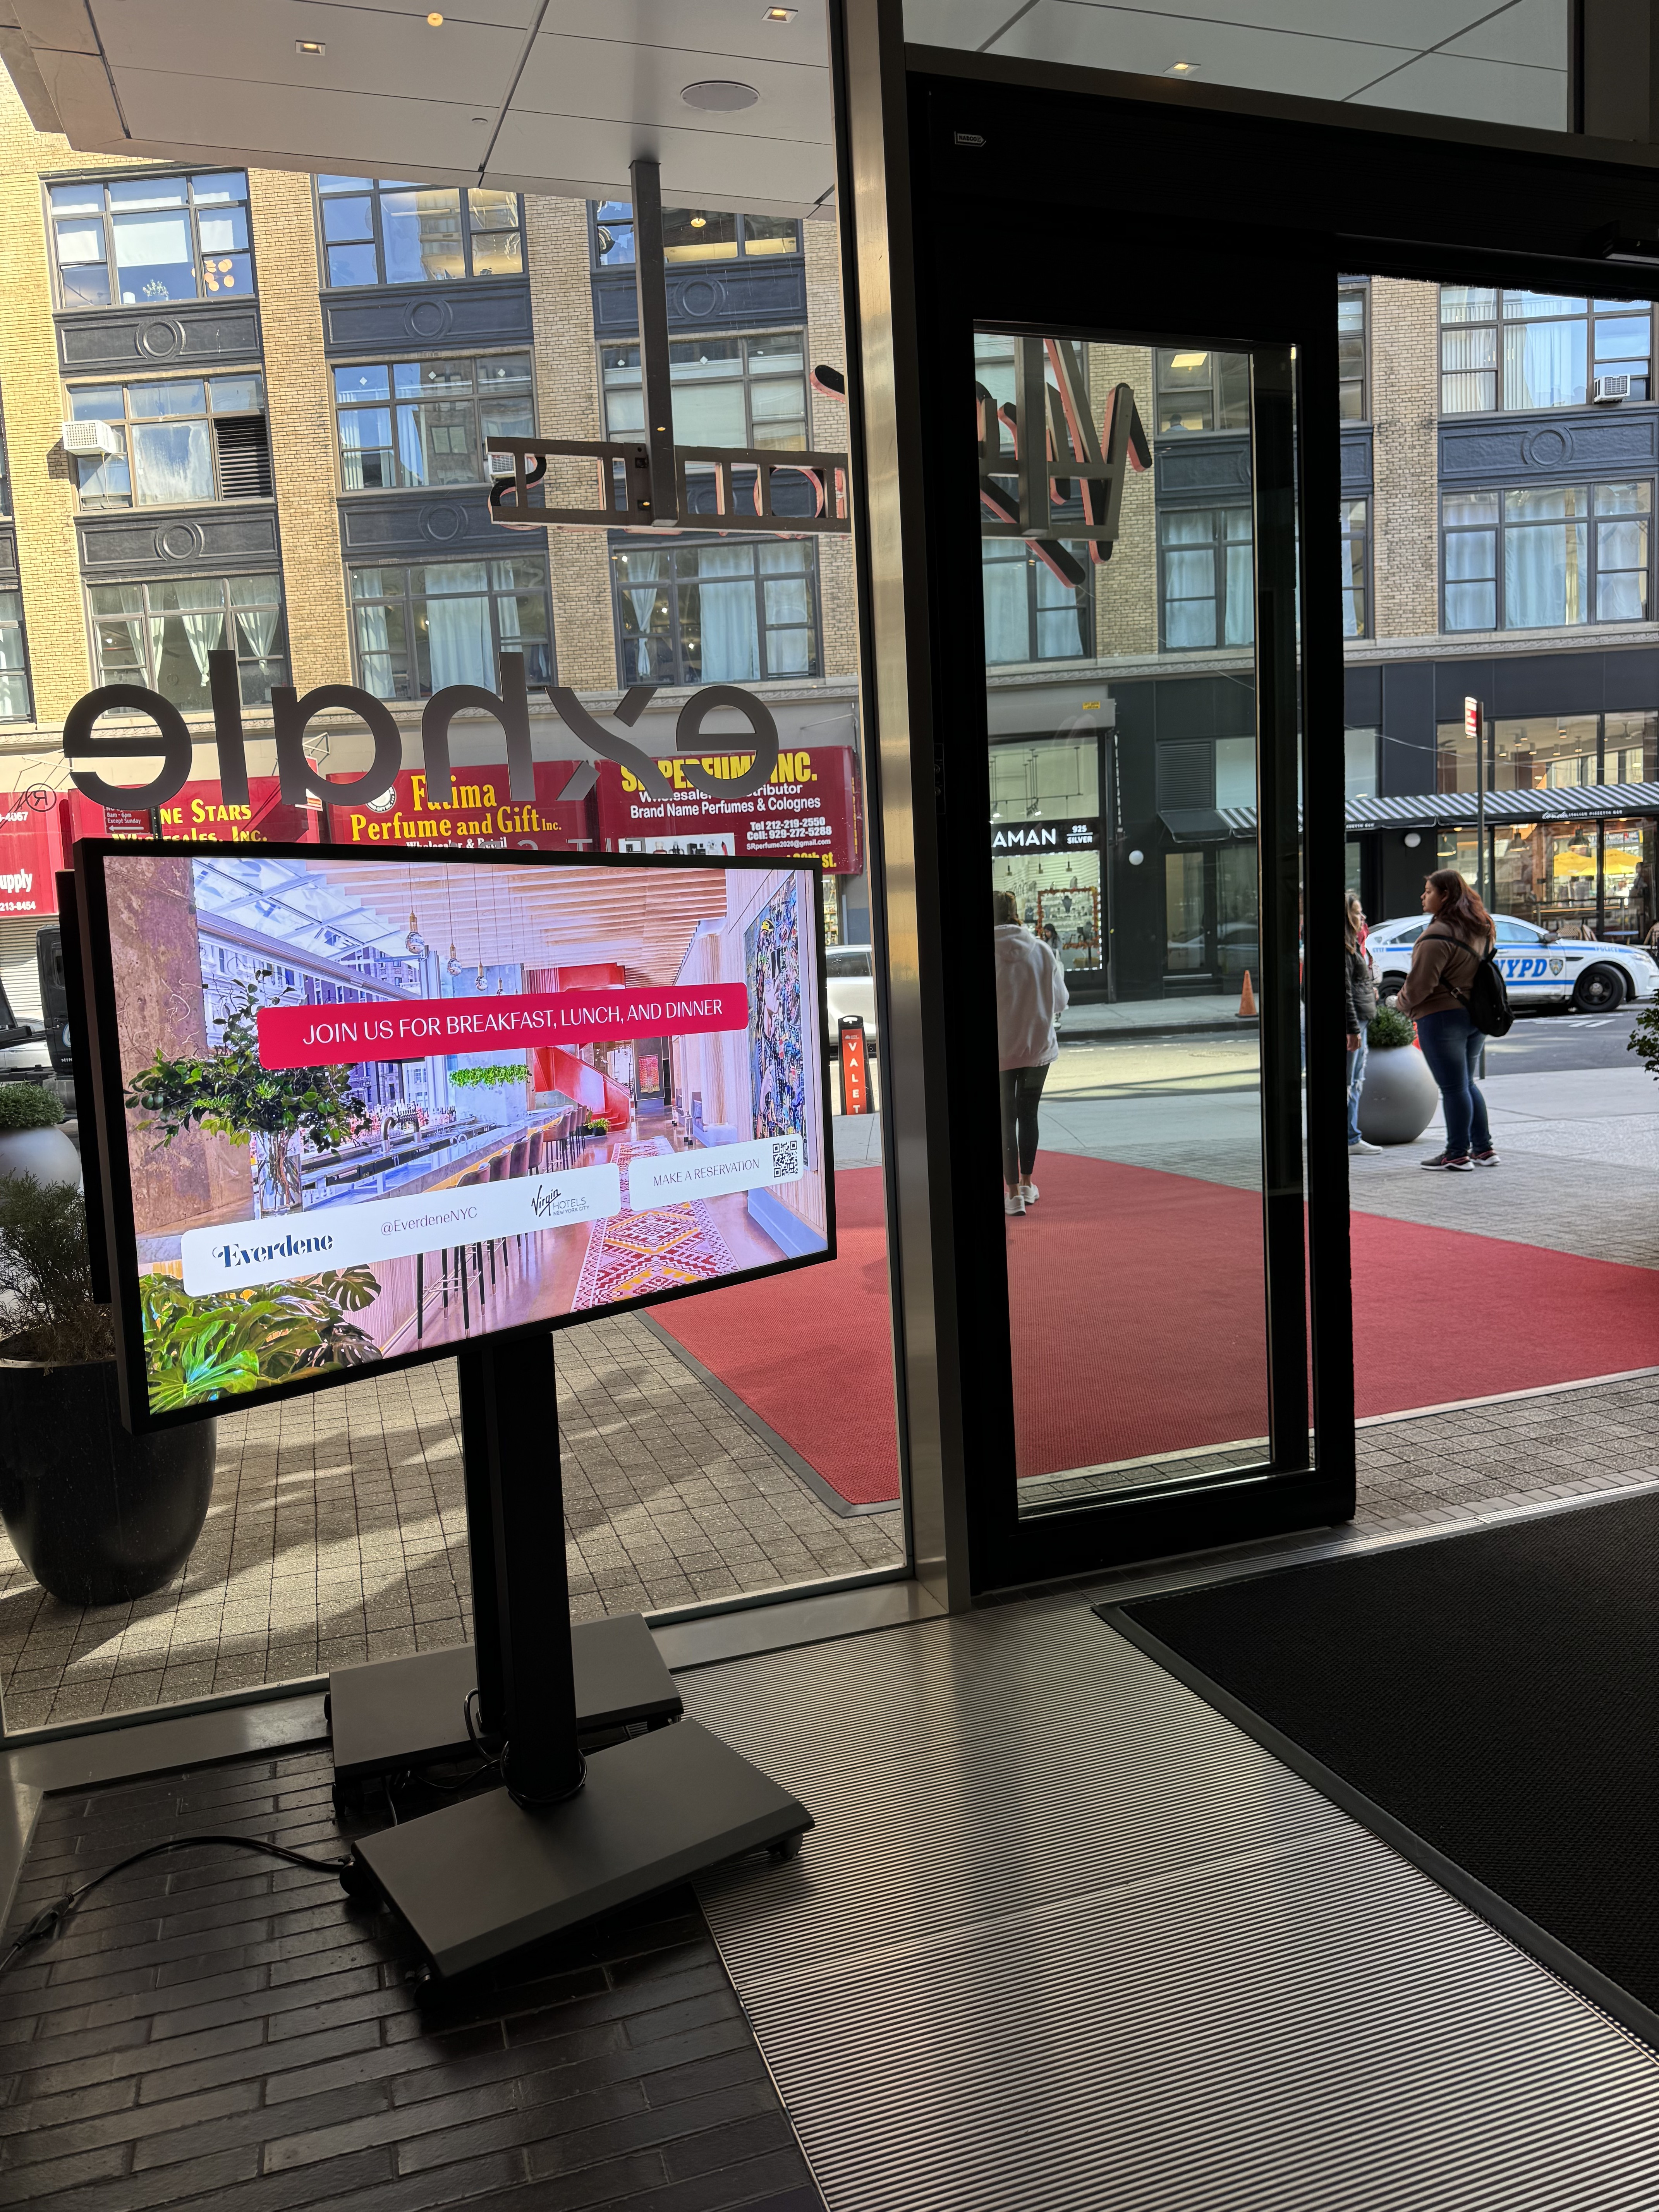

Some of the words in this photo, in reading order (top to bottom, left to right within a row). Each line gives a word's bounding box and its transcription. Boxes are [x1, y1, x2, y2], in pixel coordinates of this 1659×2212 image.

[411, 775, 497, 811] Fima
[630, 803, 664, 818] Brand
[667, 803, 699, 816] Name
[701, 800, 754, 815] Perfumes
[757, 798, 766, 811] &
[768, 796, 821, 812] Colognes
[350, 812, 452, 841] Perfume
[457, 814, 493, 836] and
[498, 805, 540, 833] Gift
[543, 818, 561, 831] Inc.
[747, 830, 768, 840] Cell:
[769, 826, 832, 839] 929-272-5288
[750, 821, 764, 831] Tel
[766, 816, 825, 830] 212-219-2550
[747, 839, 831, 851] SRperfume2020@gmail.com
[992, 828, 1056, 848] AMAN
[1067, 835, 1092, 844] SILVER
[303, 1022, 357, 1045] JOIN
[364, 1020, 393, 1040] US
[400, 1017, 441, 1038] FOR
[447, 1010, 556, 1034] BREAKFAST,
[561, 1006, 624, 1026] LUNCH,
[627, 1003, 662, 1021] AND
[666, 999, 723, 1018] DINNER
[848, 1042, 860, 1113] VALET
[654, 1172, 682, 1186] MAKE
[685, 1171, 692, 1181] A
[694, 1158, 759, 1179] RESERVATION
[531, 1185, 561, 1217] Virgin
[553, 1197, 586, 1210] HOTELS
[381, 1206, 477, 1236] @EverdeneNYC
[213, 1235, 333, 1268] Everdene
